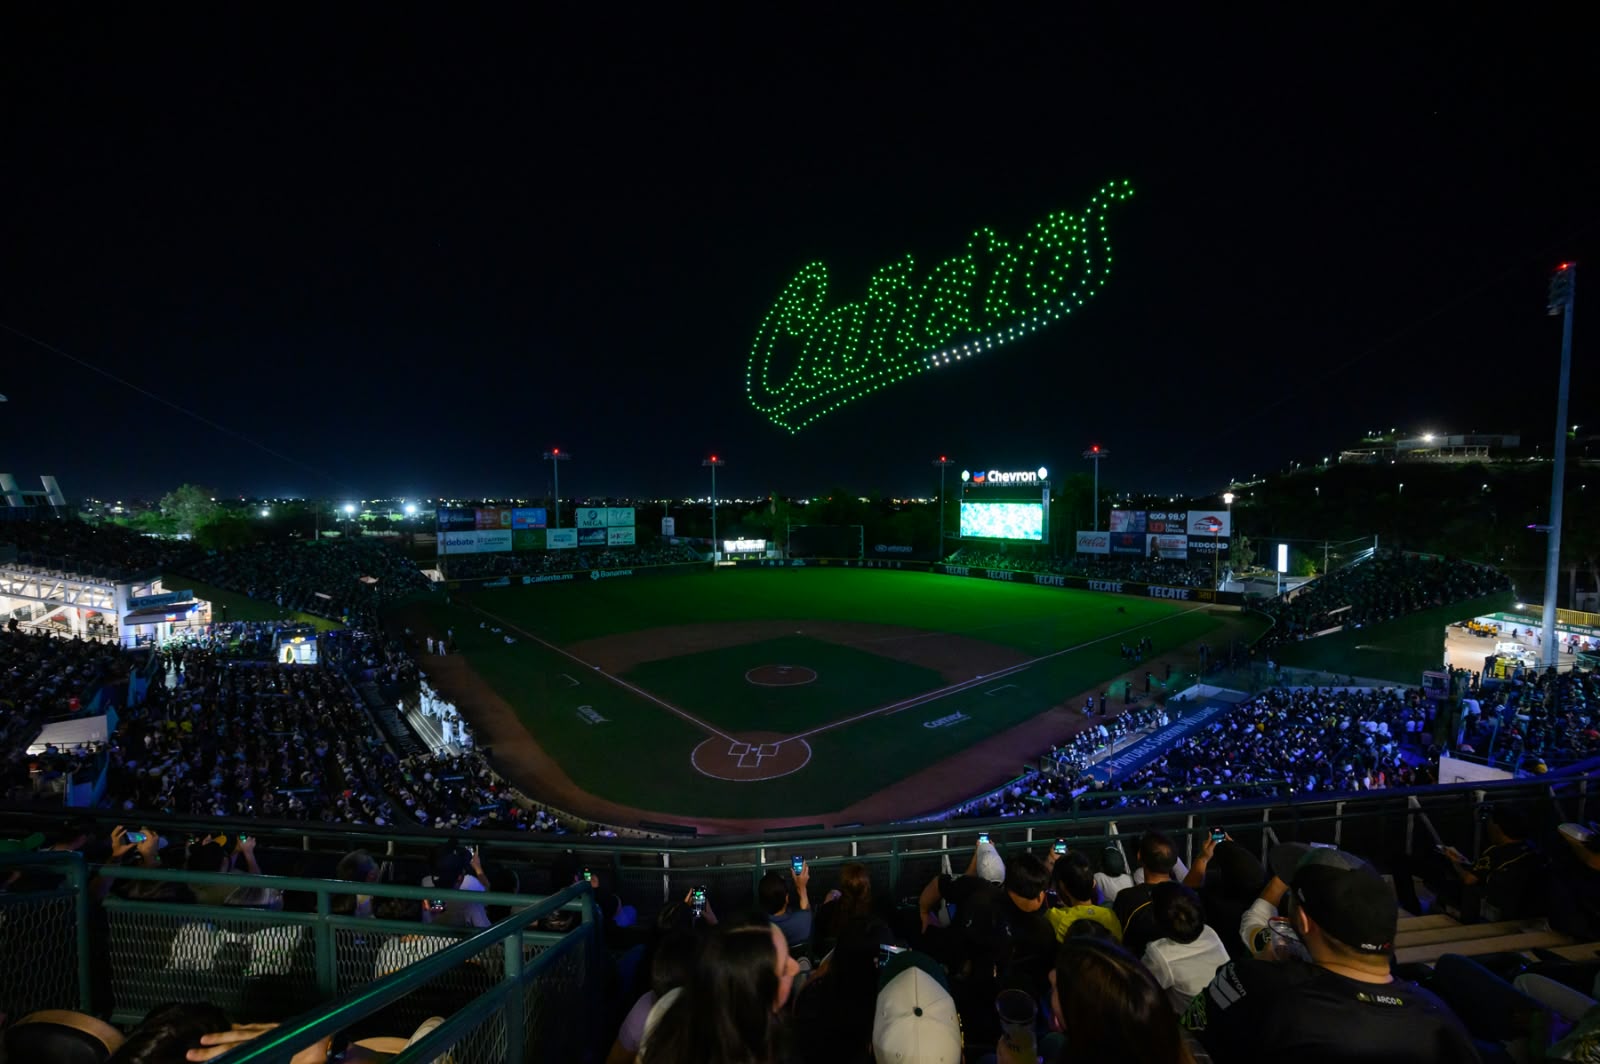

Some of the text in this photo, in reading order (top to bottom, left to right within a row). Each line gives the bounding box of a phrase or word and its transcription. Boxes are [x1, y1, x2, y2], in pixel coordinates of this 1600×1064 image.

[987, 470, 1036, 482] Chevron
[446, 537, 475, 546] debate
[600, 569, 632, 578] Banamex
[945, 565, 970, 576] TECATE
[985, 569, 1014, 581] TECATE
[1033, 574, 1065, 586] TECATE
[1088, 580, 1123, 593] TECATE
[1147, 586, 1190, 600] TECATE
[1570, 626, 1592, 635] TORTAS
[1105, 742, 1157, 769] PINTURAS
